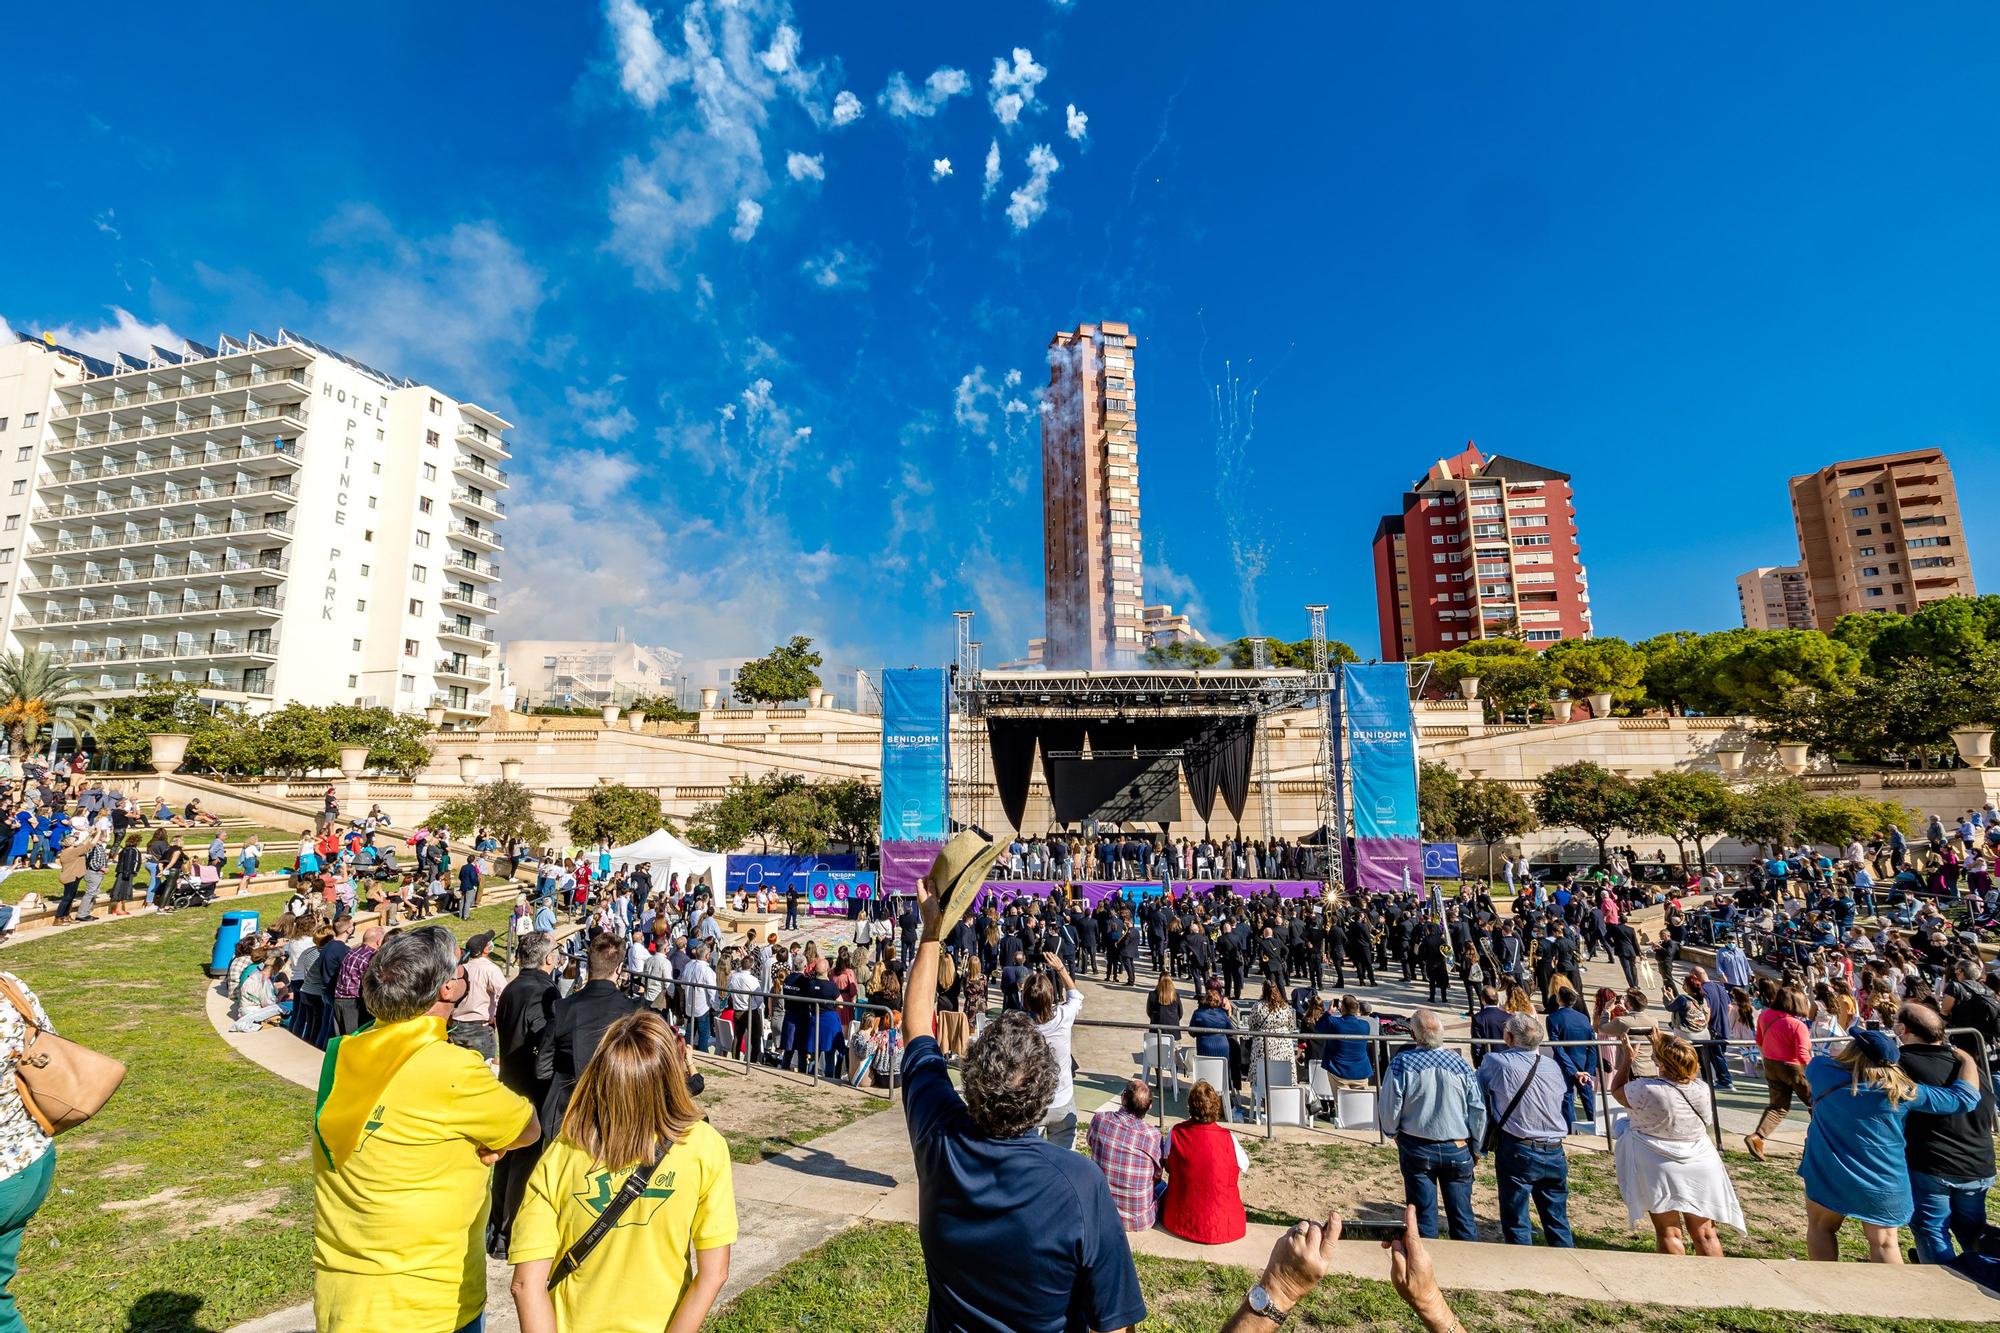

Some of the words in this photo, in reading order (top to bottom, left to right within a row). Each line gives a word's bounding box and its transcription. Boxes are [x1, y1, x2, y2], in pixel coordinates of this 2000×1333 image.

[323, 381, 383, 422] HOTEL
[335, 418, 357, 526] PRINCE
[322, 547, 341, 621] PARK
[887, 735, 939, 743] BENIDORM
[1353, 731, 1407, 739] BENIDORM
